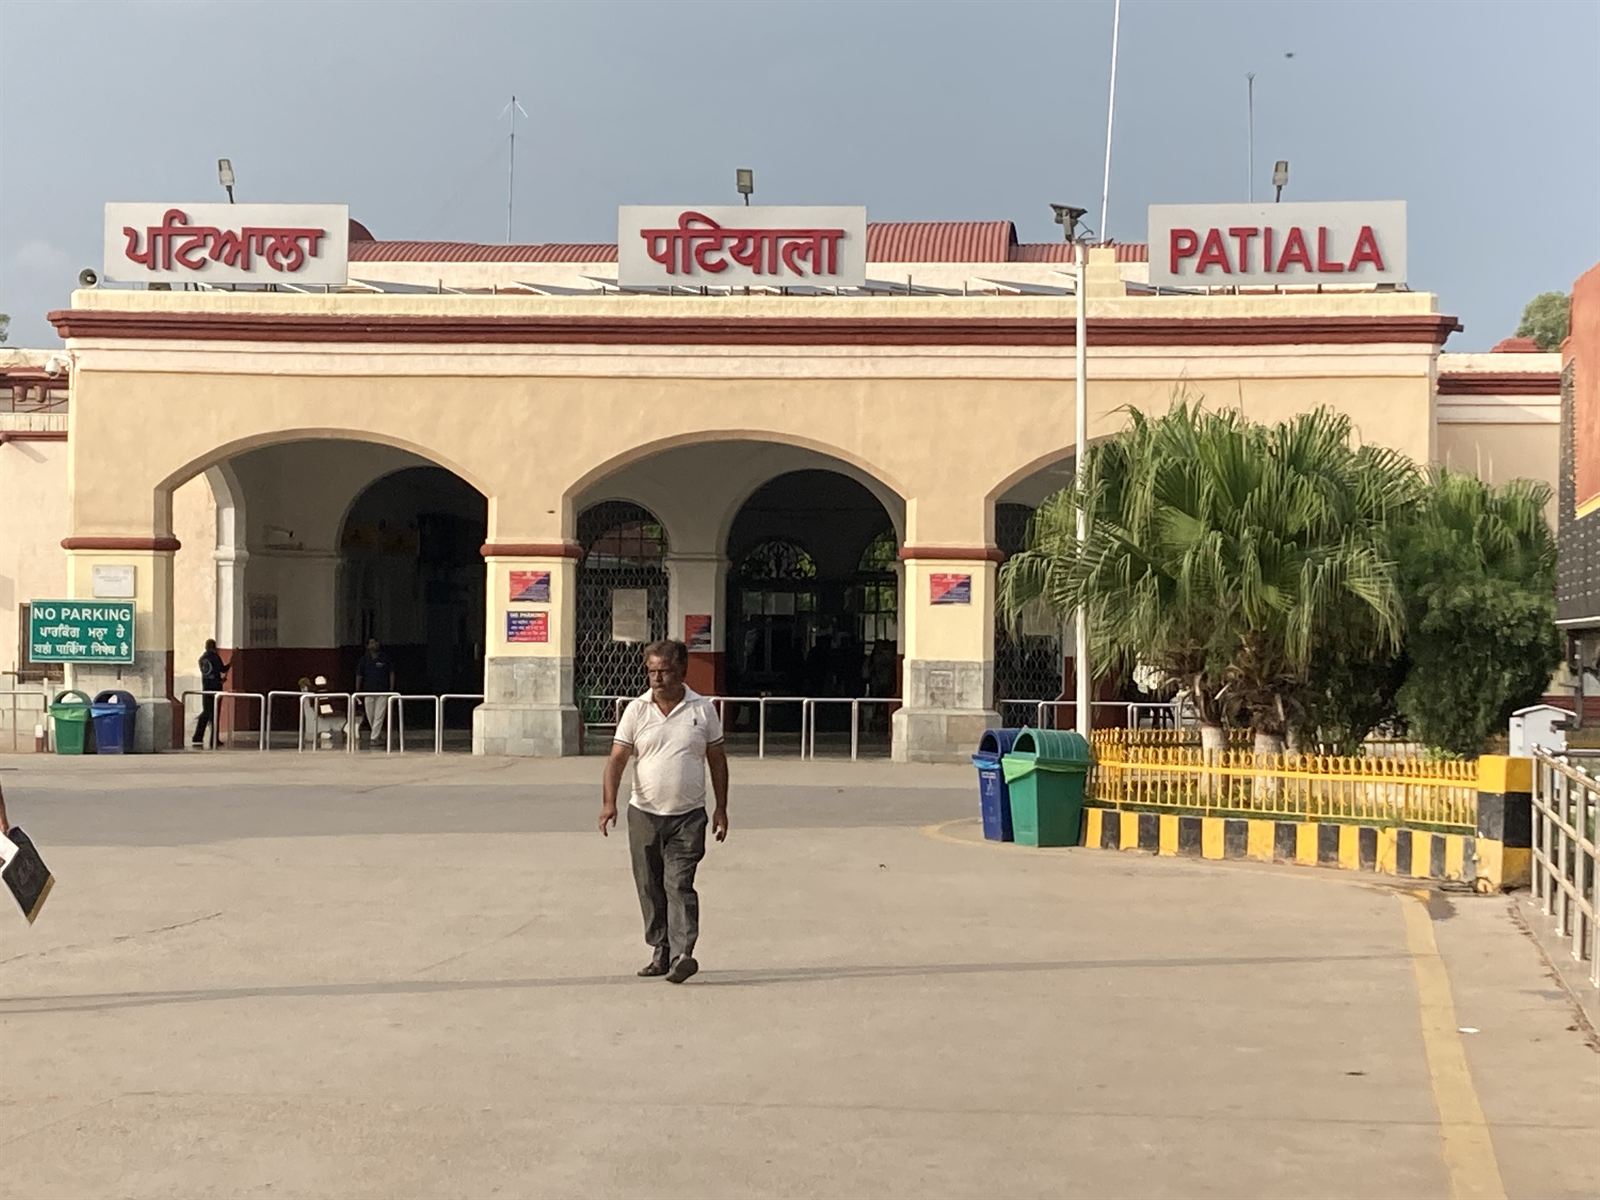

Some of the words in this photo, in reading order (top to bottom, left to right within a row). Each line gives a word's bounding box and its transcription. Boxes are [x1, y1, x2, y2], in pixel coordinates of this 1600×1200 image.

[123, 208, 325, 272] ਪਟਿਆਲਾ
[640, 211, 845, 277] पटियाला
[1170, 225, 1385, 274] PATIALA
[33, 607, 56, 620] NO
[61, 607, 131, 621] PARKING
[116, 623, 125, 638] ਹੈ
[120, 641, 129, 656] है
